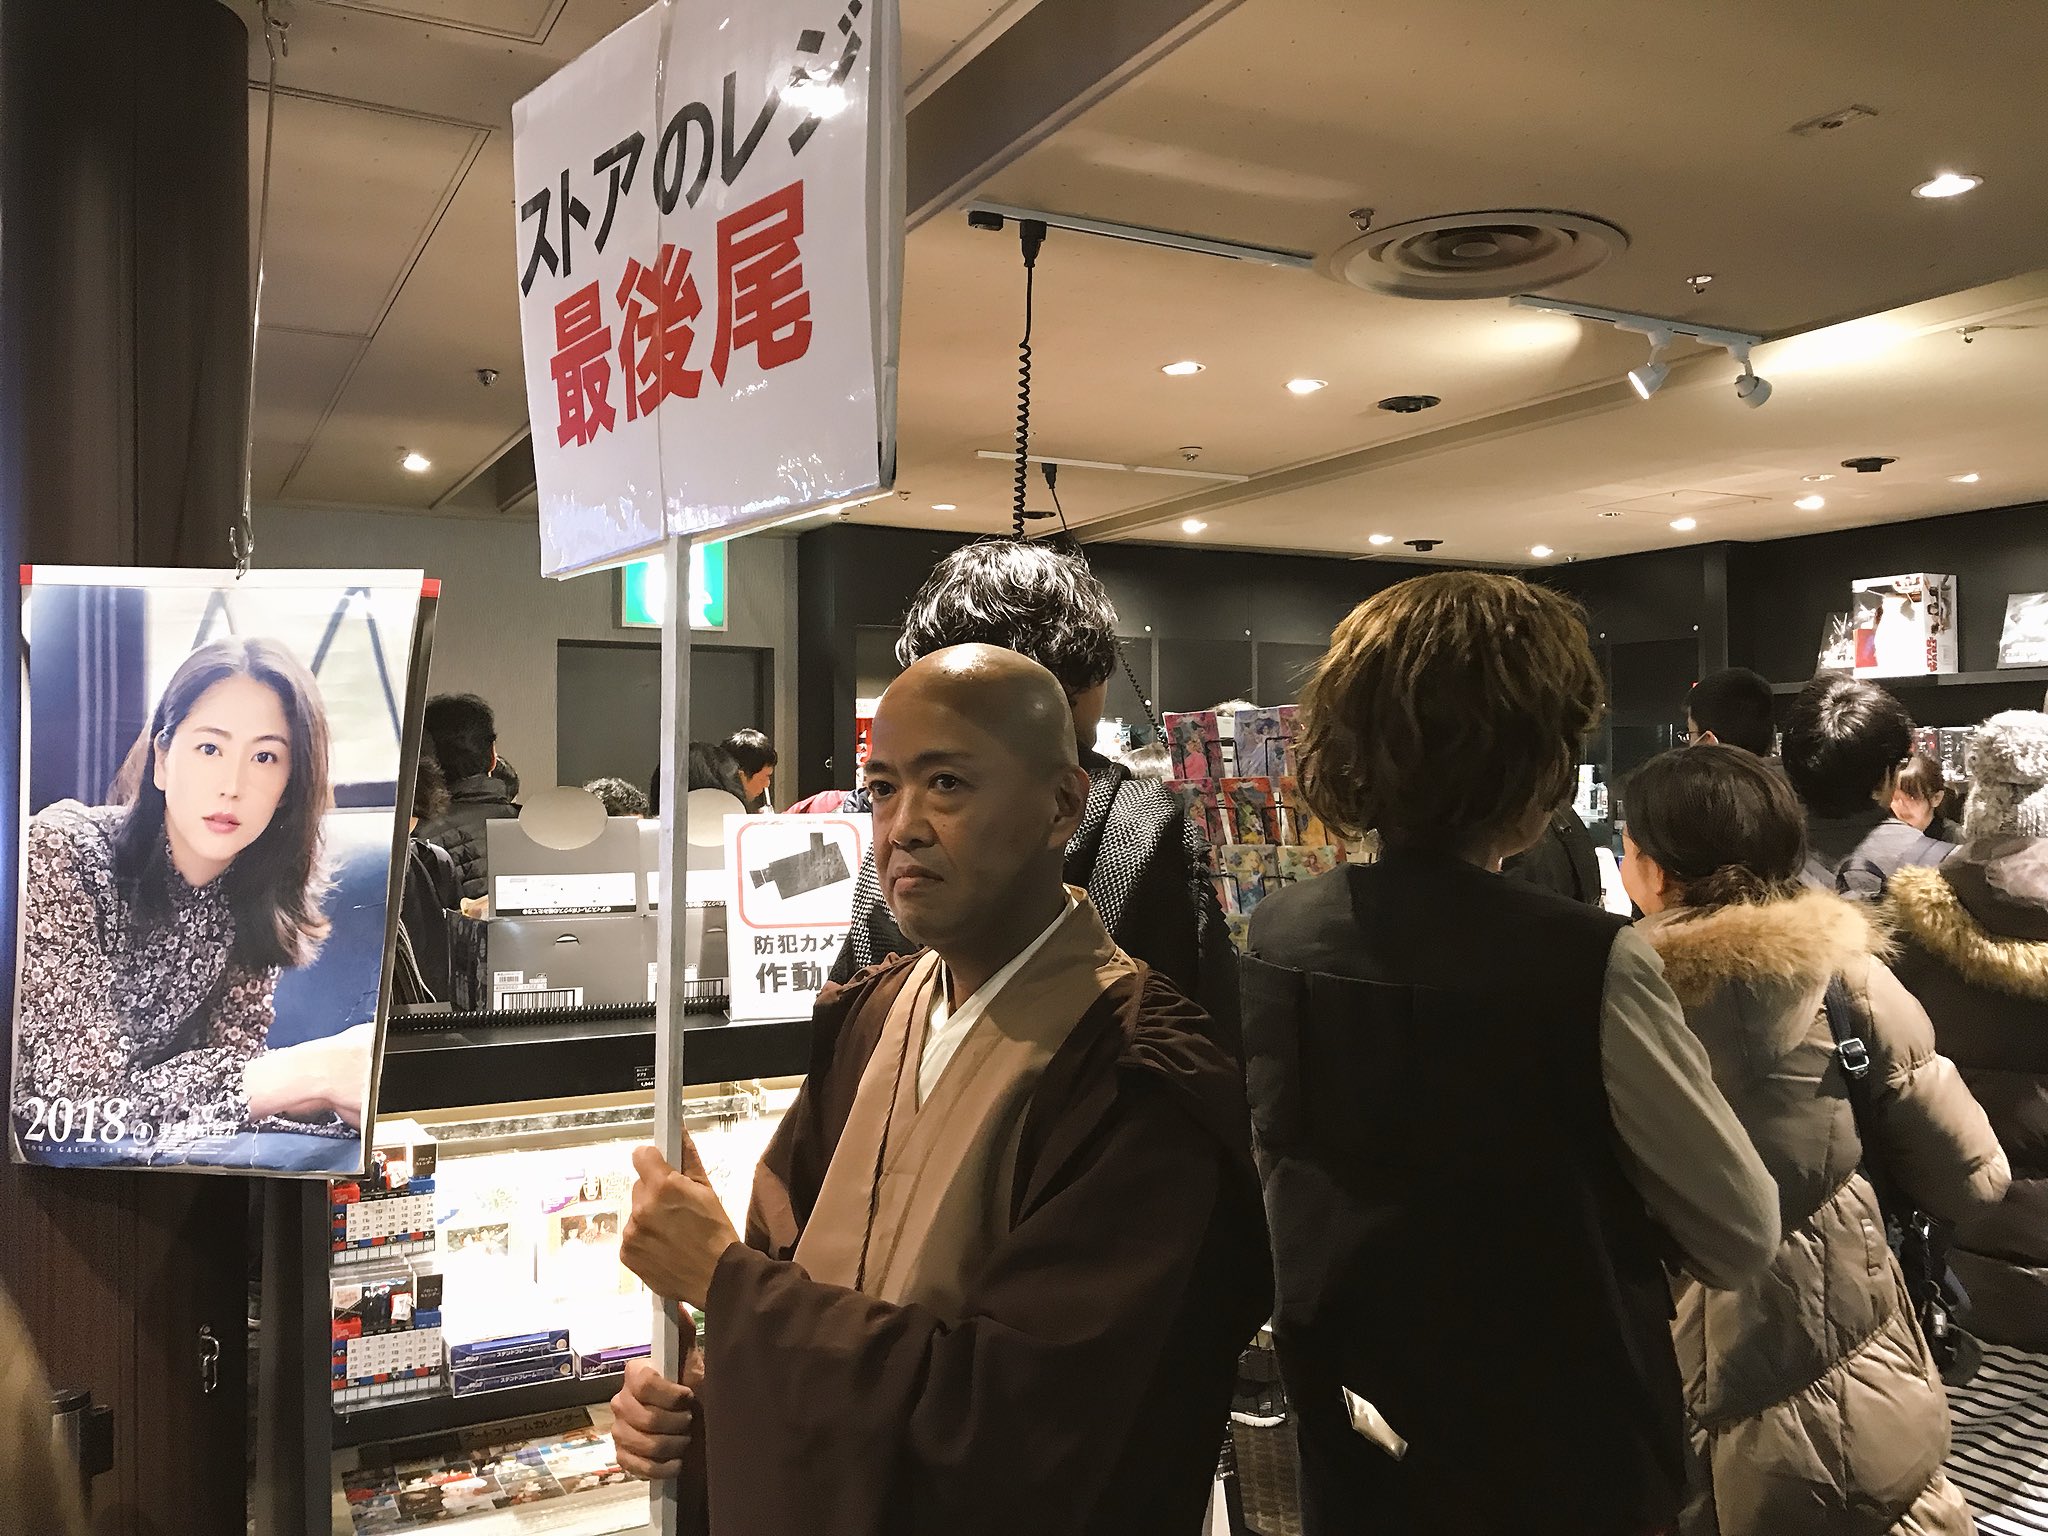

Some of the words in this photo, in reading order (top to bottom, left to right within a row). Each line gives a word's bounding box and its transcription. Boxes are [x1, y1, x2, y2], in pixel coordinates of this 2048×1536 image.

[520, 0, 862, 297] ストアのレジ
[550, 179, 814, 449] 最後尾
[755, 961, 834, 993] 作動
[24, 1096, 130, 1144] 2018
